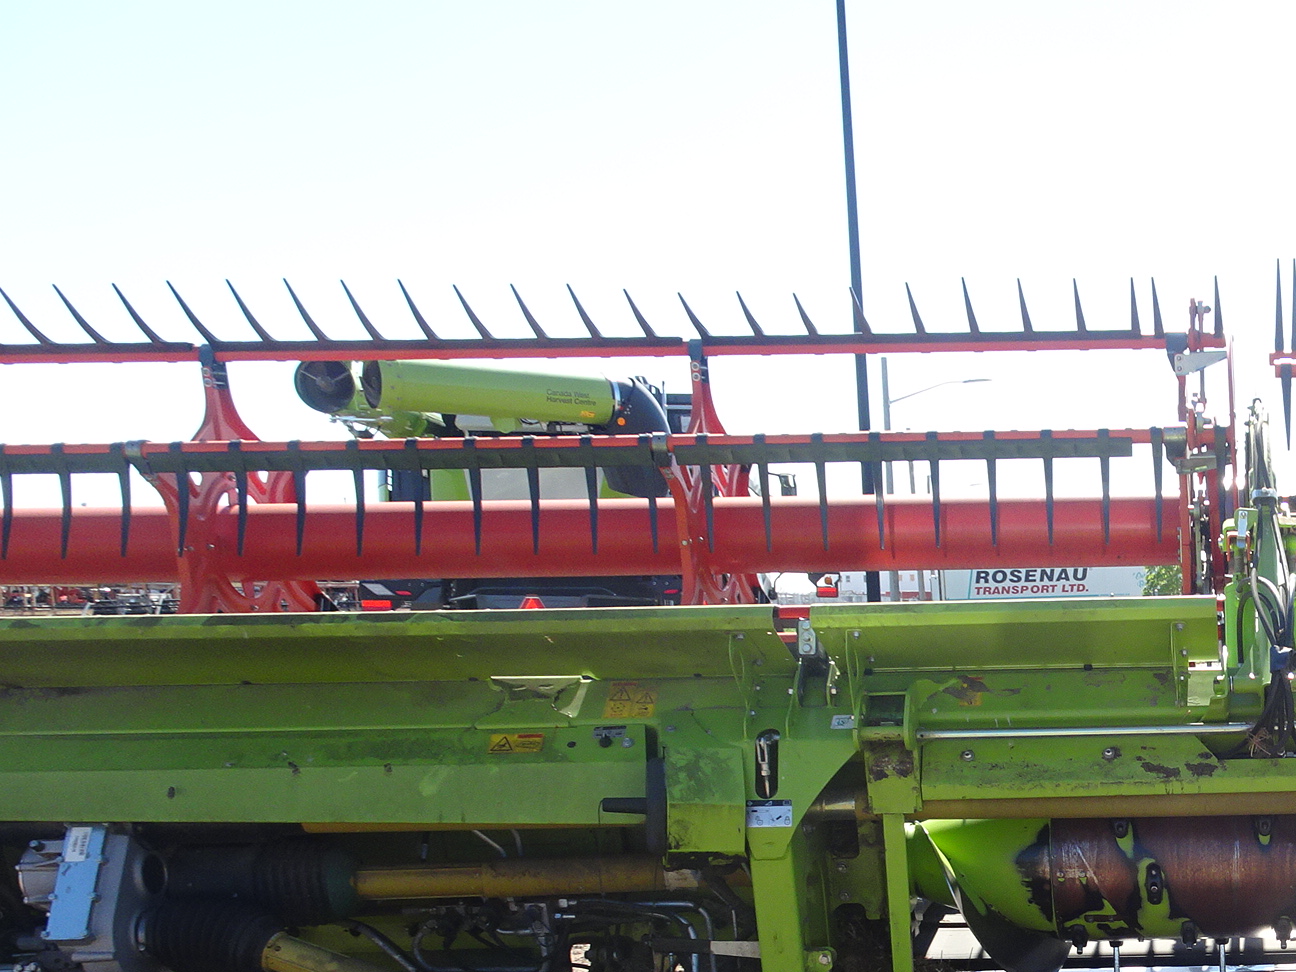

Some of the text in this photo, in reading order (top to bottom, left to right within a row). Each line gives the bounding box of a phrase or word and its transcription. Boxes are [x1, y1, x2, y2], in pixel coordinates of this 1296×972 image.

[546, 388, 572, 396] Canada
[546, 396, 597, 406] Harvest Centre
[974, 567, 1088, 584] ROSENAU
[974, 583, 1089, 596] TRANSPORT LTD.
